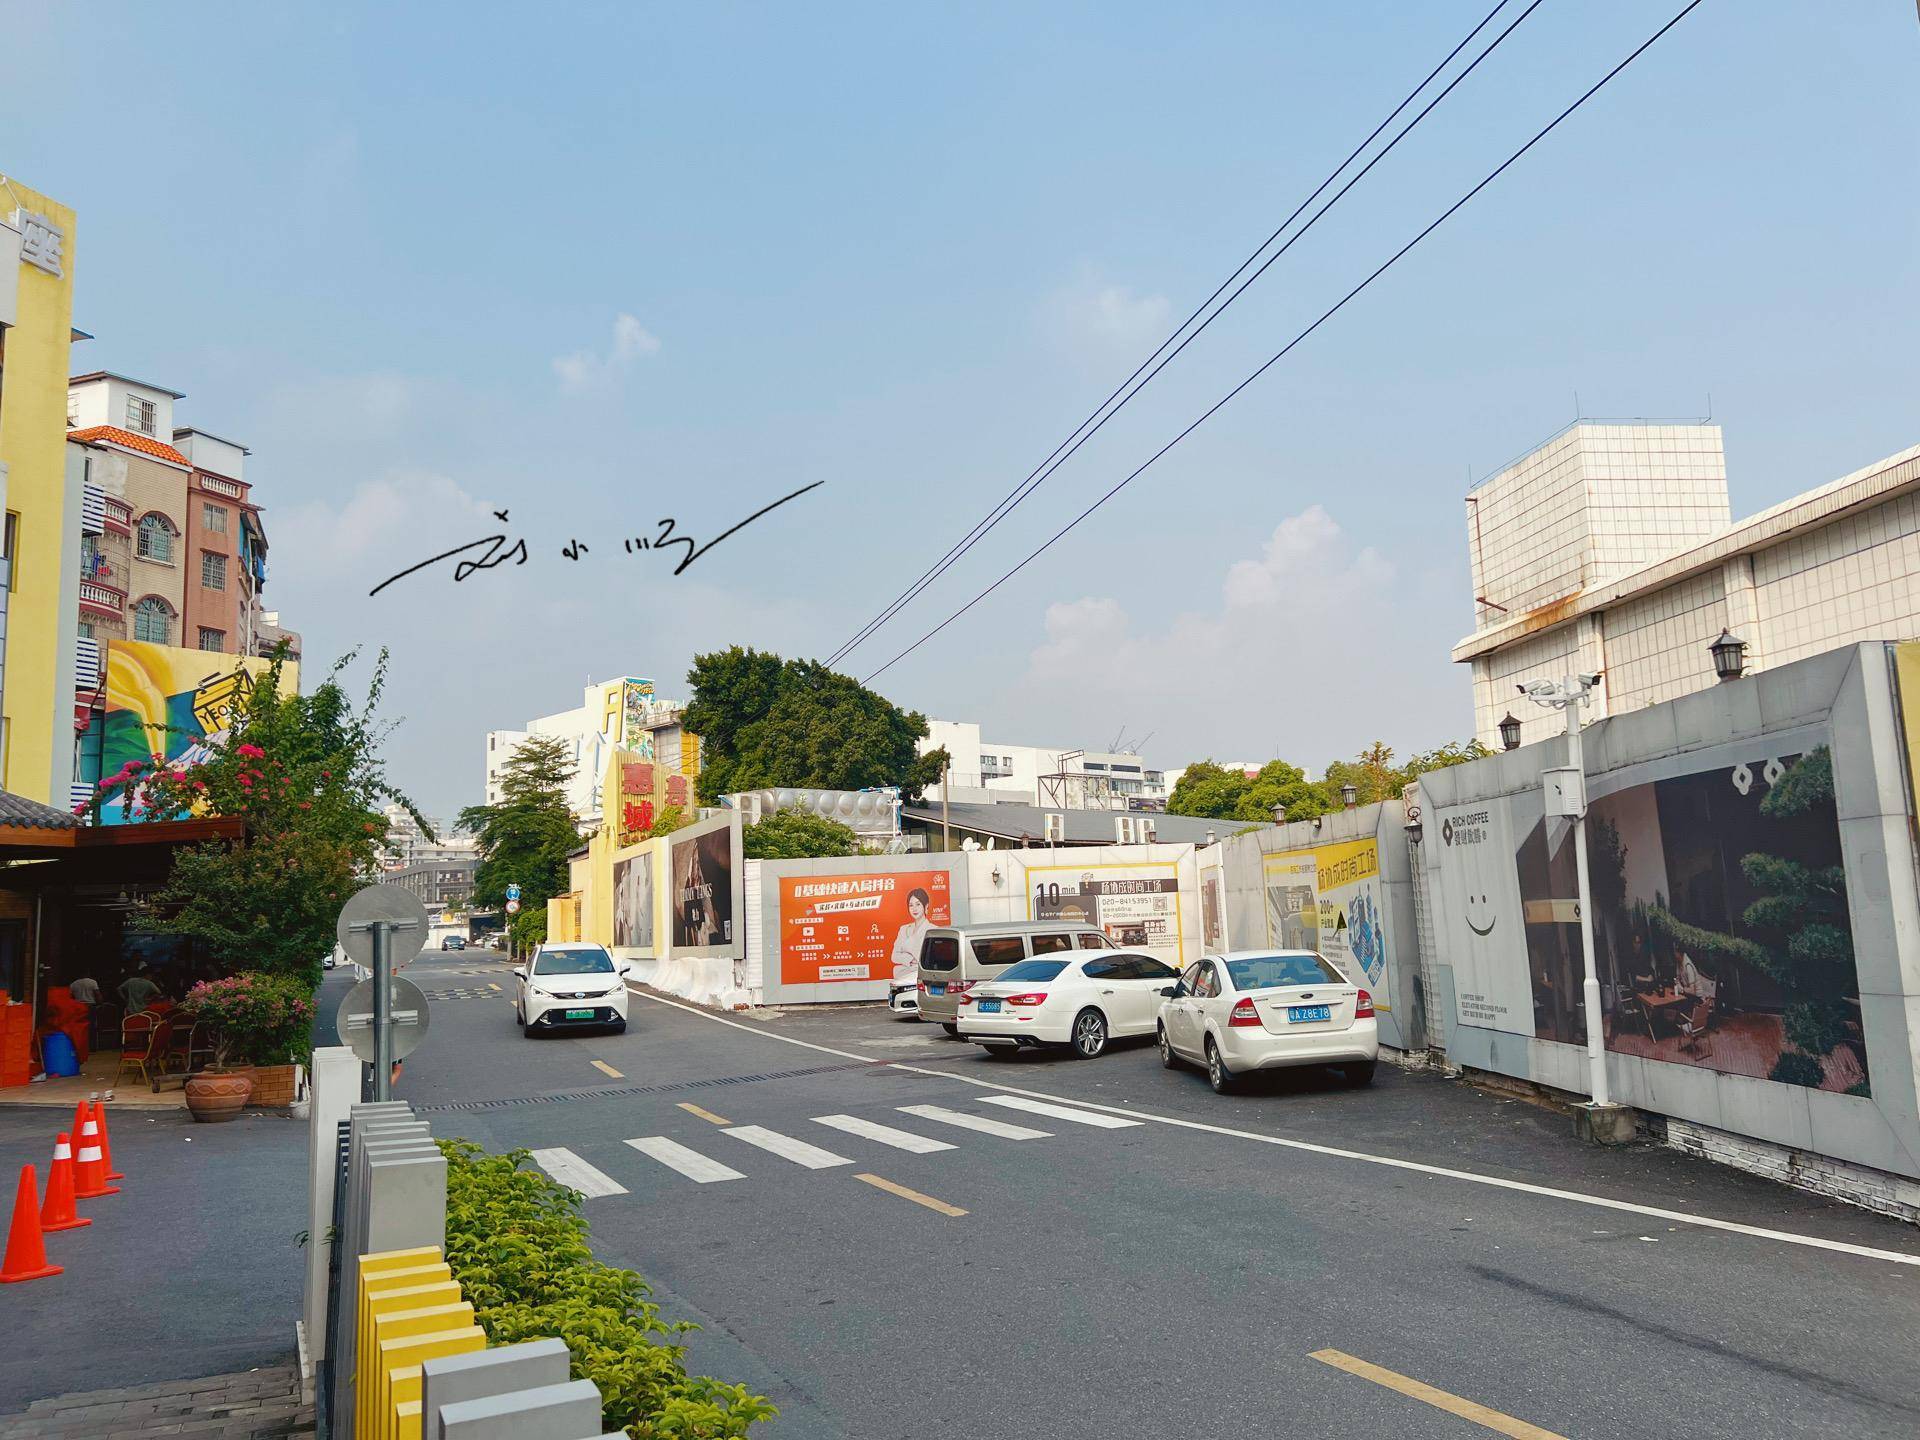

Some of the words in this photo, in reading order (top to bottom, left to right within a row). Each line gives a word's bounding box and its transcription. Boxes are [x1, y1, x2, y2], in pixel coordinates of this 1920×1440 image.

[1452, 816, 1466, 827] RICH
[1466, 811, 1489, 826] COFFEE
[1036, 882, 1060, 907] 10
[1061, 886, 1076, 895] min
[1320, 899, 1334, 914] 200+
